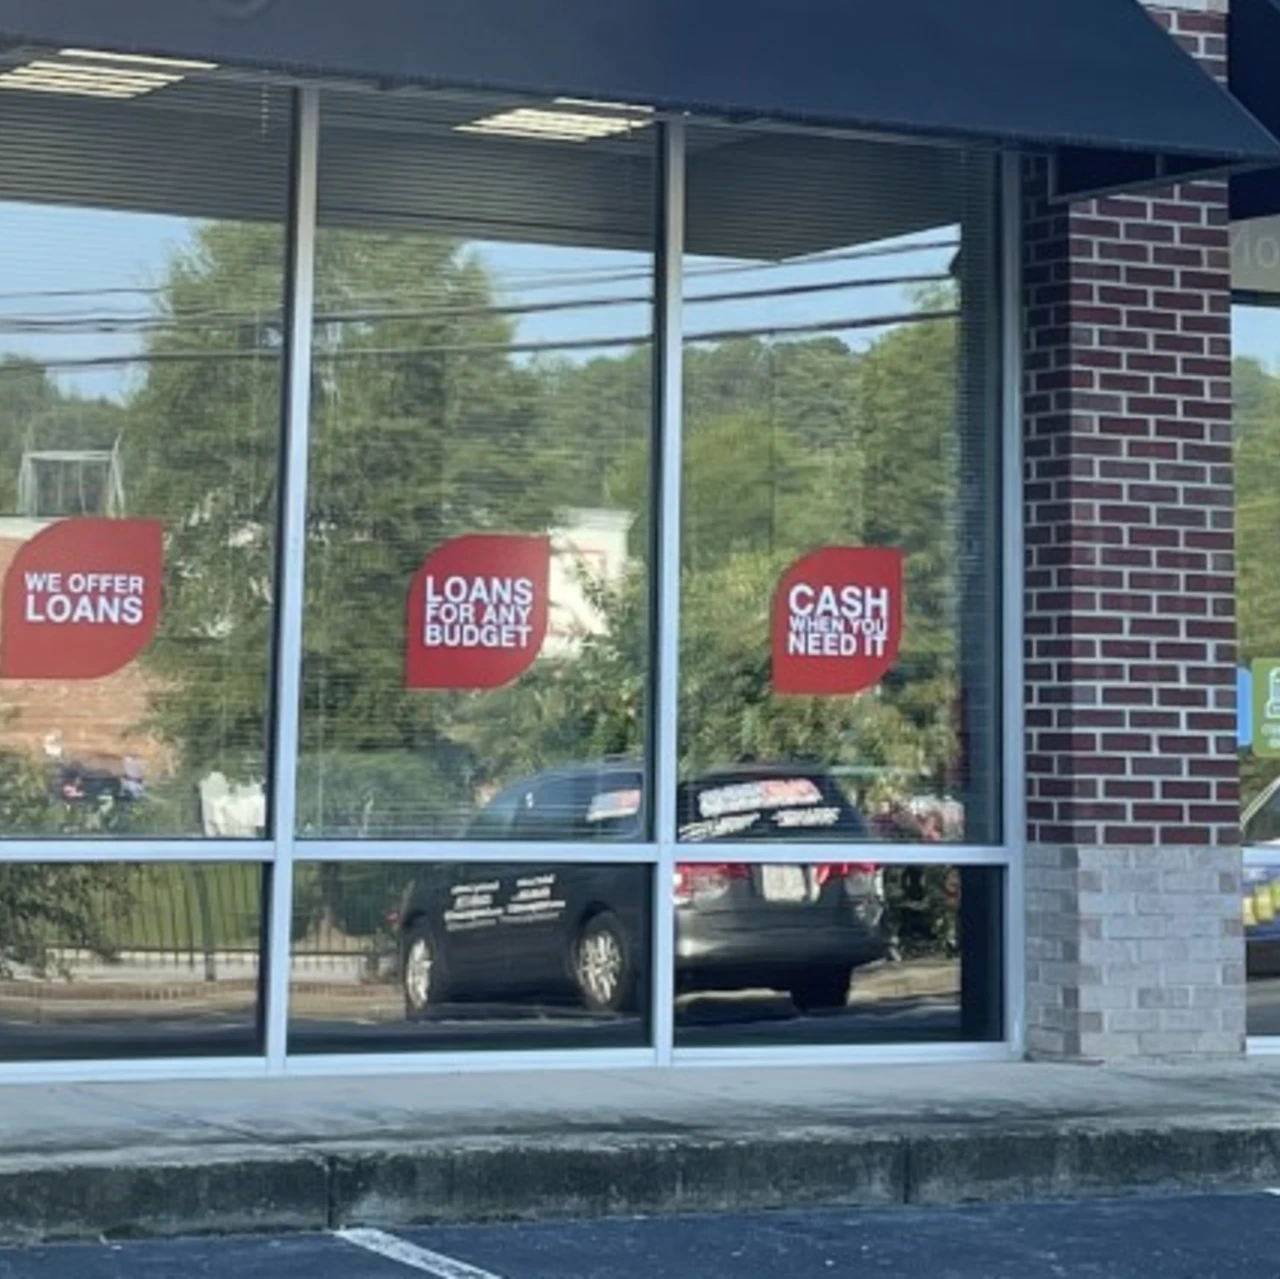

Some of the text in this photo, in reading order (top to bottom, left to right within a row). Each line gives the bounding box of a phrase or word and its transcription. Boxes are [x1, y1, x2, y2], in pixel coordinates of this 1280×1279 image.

[24, 572, 144, 595] WE OFFER
[425, 575, 533, 605] LOANS
[25, 593, 144, 626] LOANS
[788, 583, 888, 619] CASH
[426, 603, 533, 625] FOR ANY
[788, 615, 888, 637] WHEN YOU
[425, 624, 533, 648] BUDGET
[788, 631, 888, 658] NEED IT
